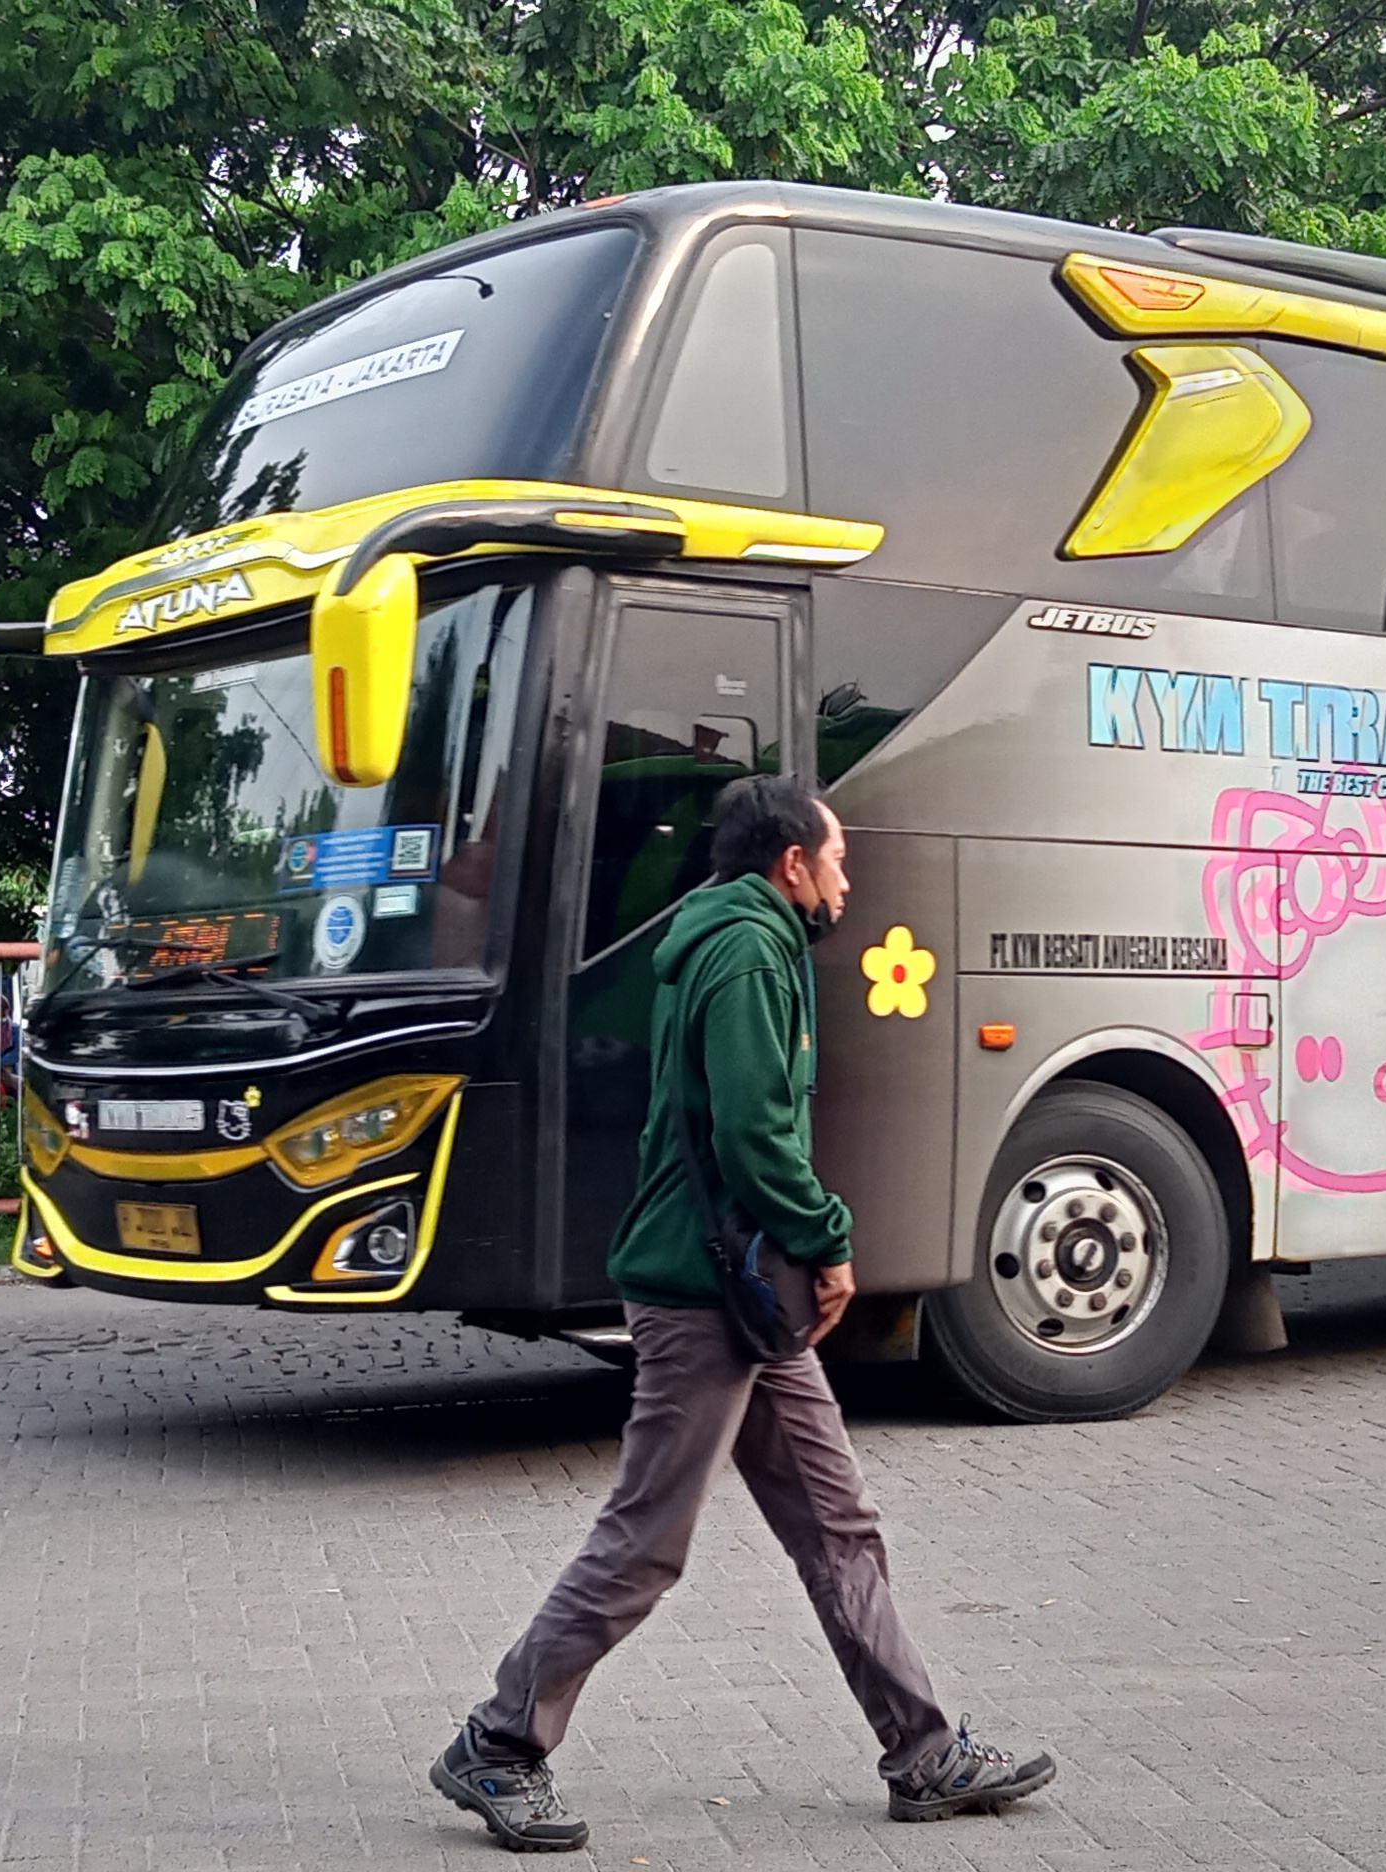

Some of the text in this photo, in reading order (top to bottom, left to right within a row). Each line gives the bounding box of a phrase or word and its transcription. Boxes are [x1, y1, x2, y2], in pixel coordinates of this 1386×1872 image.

[348, 340, 448, 388] JAKARTA
[115, 568, 253, 635] ATUNA
[1028, 606, 1157, 639] JETBUS
[1297, 769, 1331, 793] THE
[1333, 772, 1374, 798] BEST
